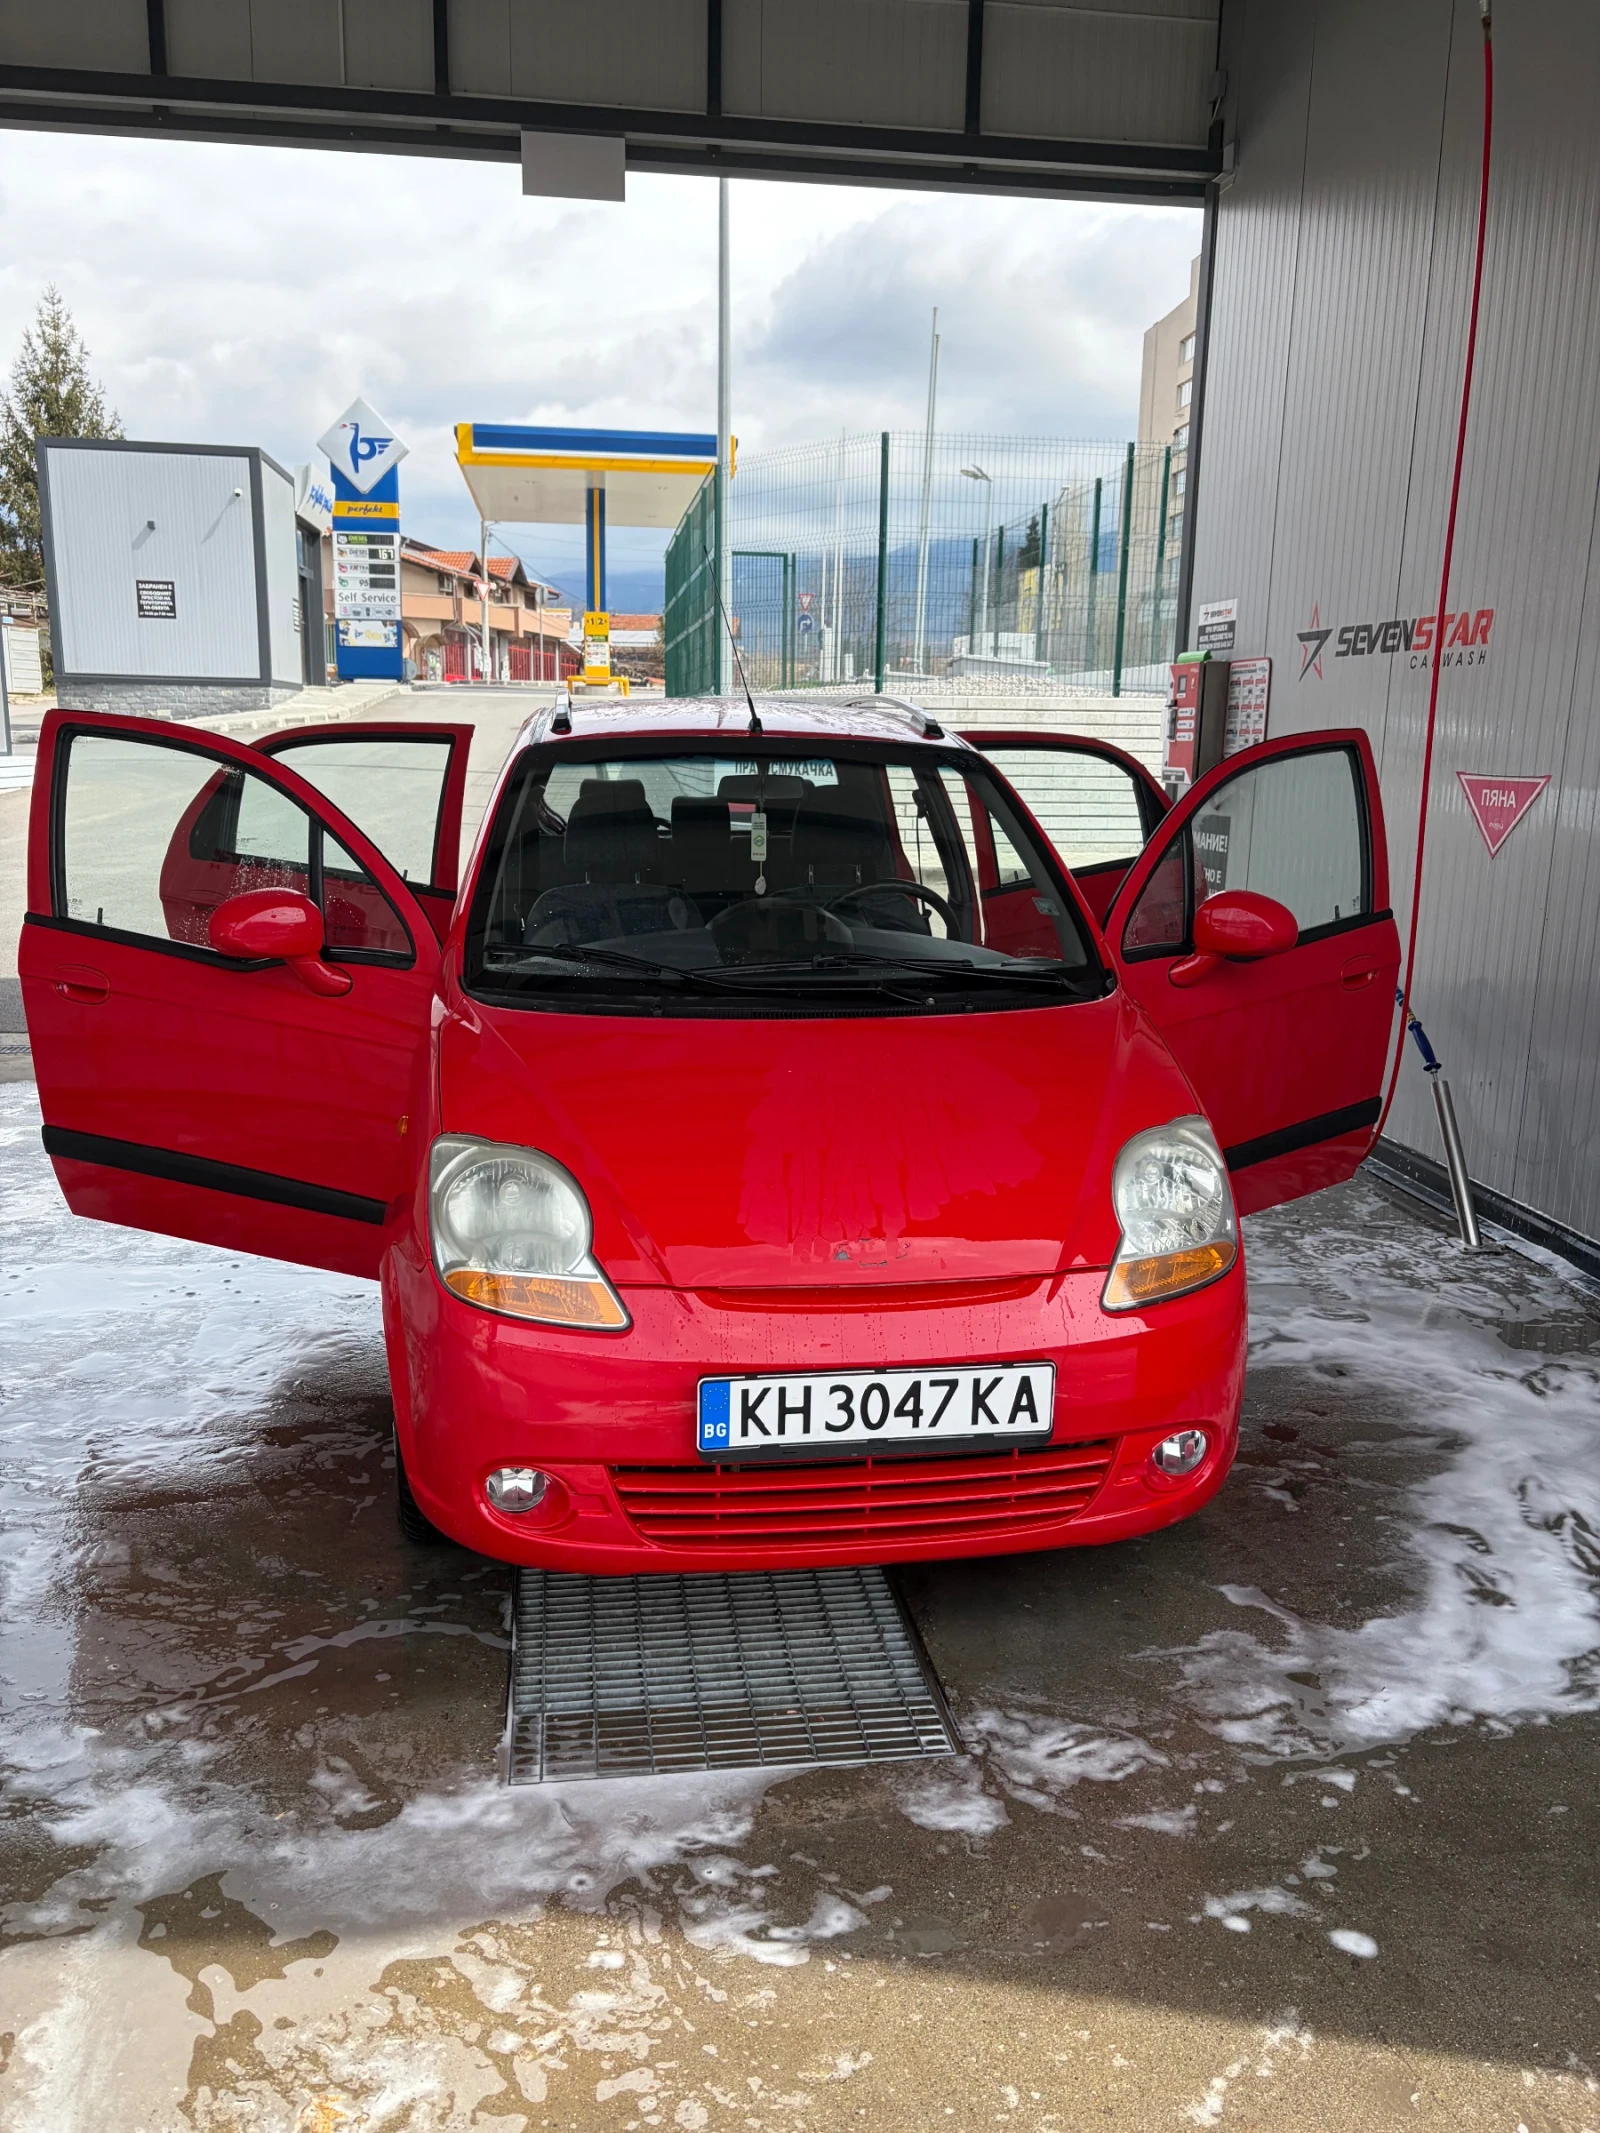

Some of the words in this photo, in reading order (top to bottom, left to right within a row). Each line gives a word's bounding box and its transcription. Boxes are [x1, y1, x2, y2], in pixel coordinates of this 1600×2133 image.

[347, 504, 383, 515] perfekt
[359, 579, 369, 587] 95
[338, 592, 357, 602] Self
[361, 593, 397, 603] Service
[598, 617, 604, 625] 2
[1410, 654, 1439, 670] CA
[1442, 650, 1487, 667] WASH
[1481, 789, 1516, 809] ПЯНА
[740, 1385, 812, 1438] KH
[824, 1378, 959, 1433] 3047
[970, 1375, 1039, 1426] KA
[704, 1423, 727, 1439] BG
